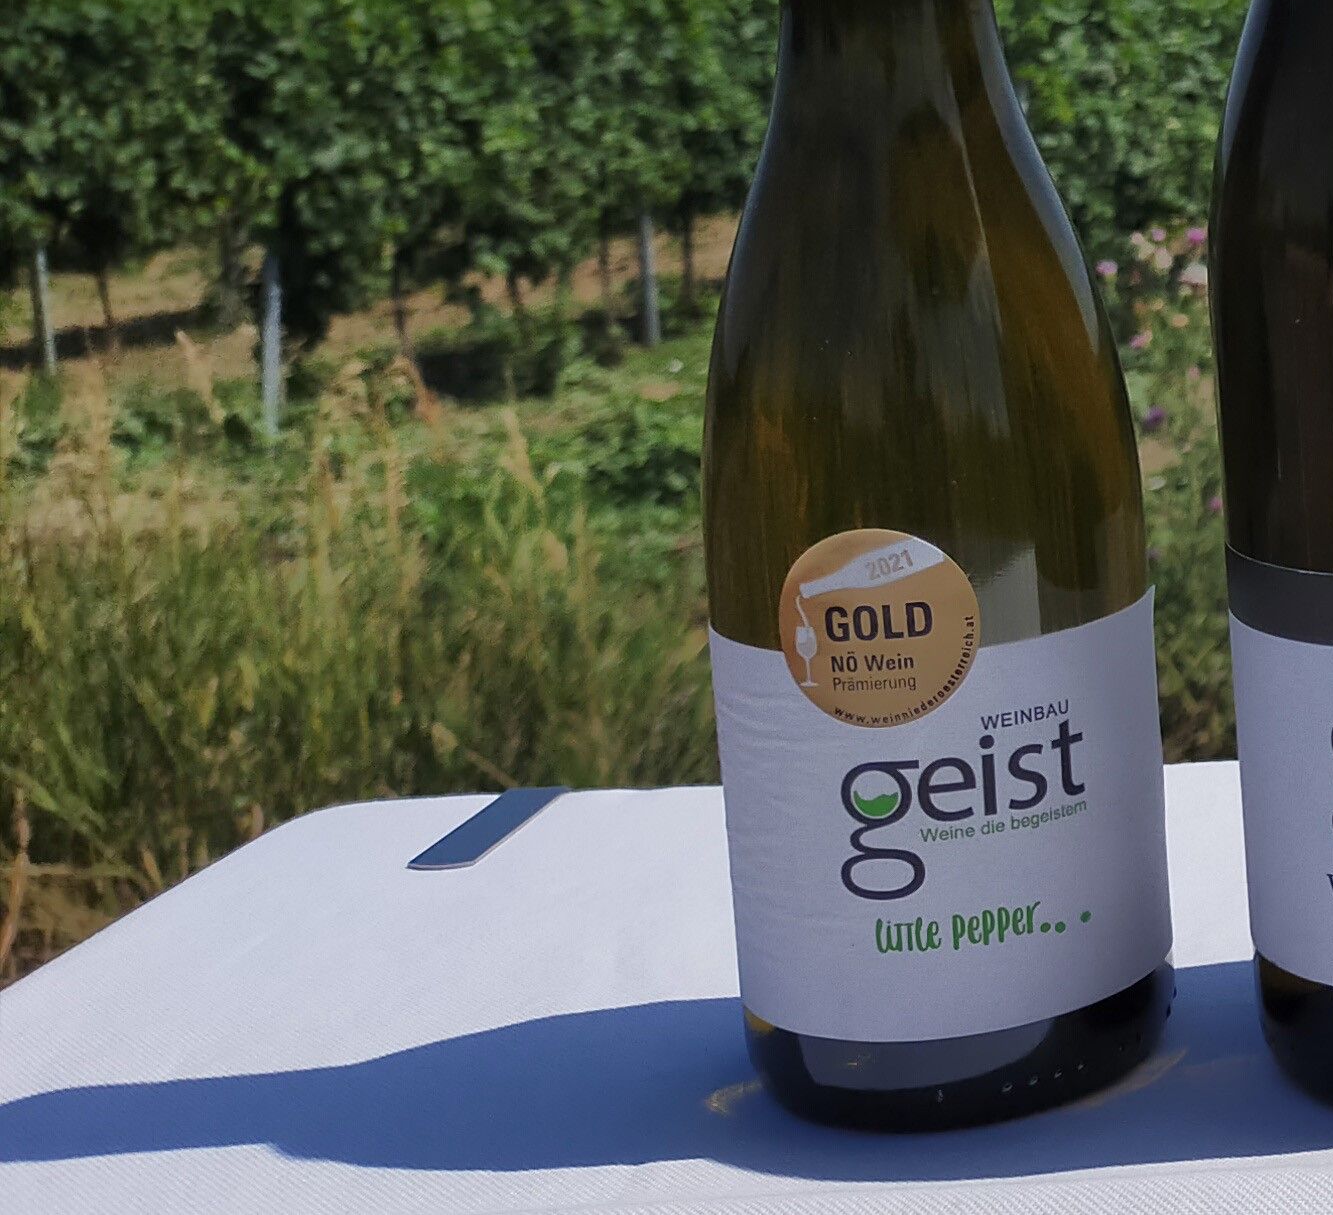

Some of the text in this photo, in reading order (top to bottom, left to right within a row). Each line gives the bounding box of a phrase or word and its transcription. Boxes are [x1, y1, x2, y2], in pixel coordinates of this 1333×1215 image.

[865, 549, 914, 581] 2021
[825, 601, 934, 643] GOLD
[831, 651, 915, 673] NÖ Wein
[833, 676, 917, 692] Prämierung
[980, 698, 1070, 731] WEINBAU
[840, 718, 1086, 901] geist
[920, 799, 1088, 843] Weine die begeistern
